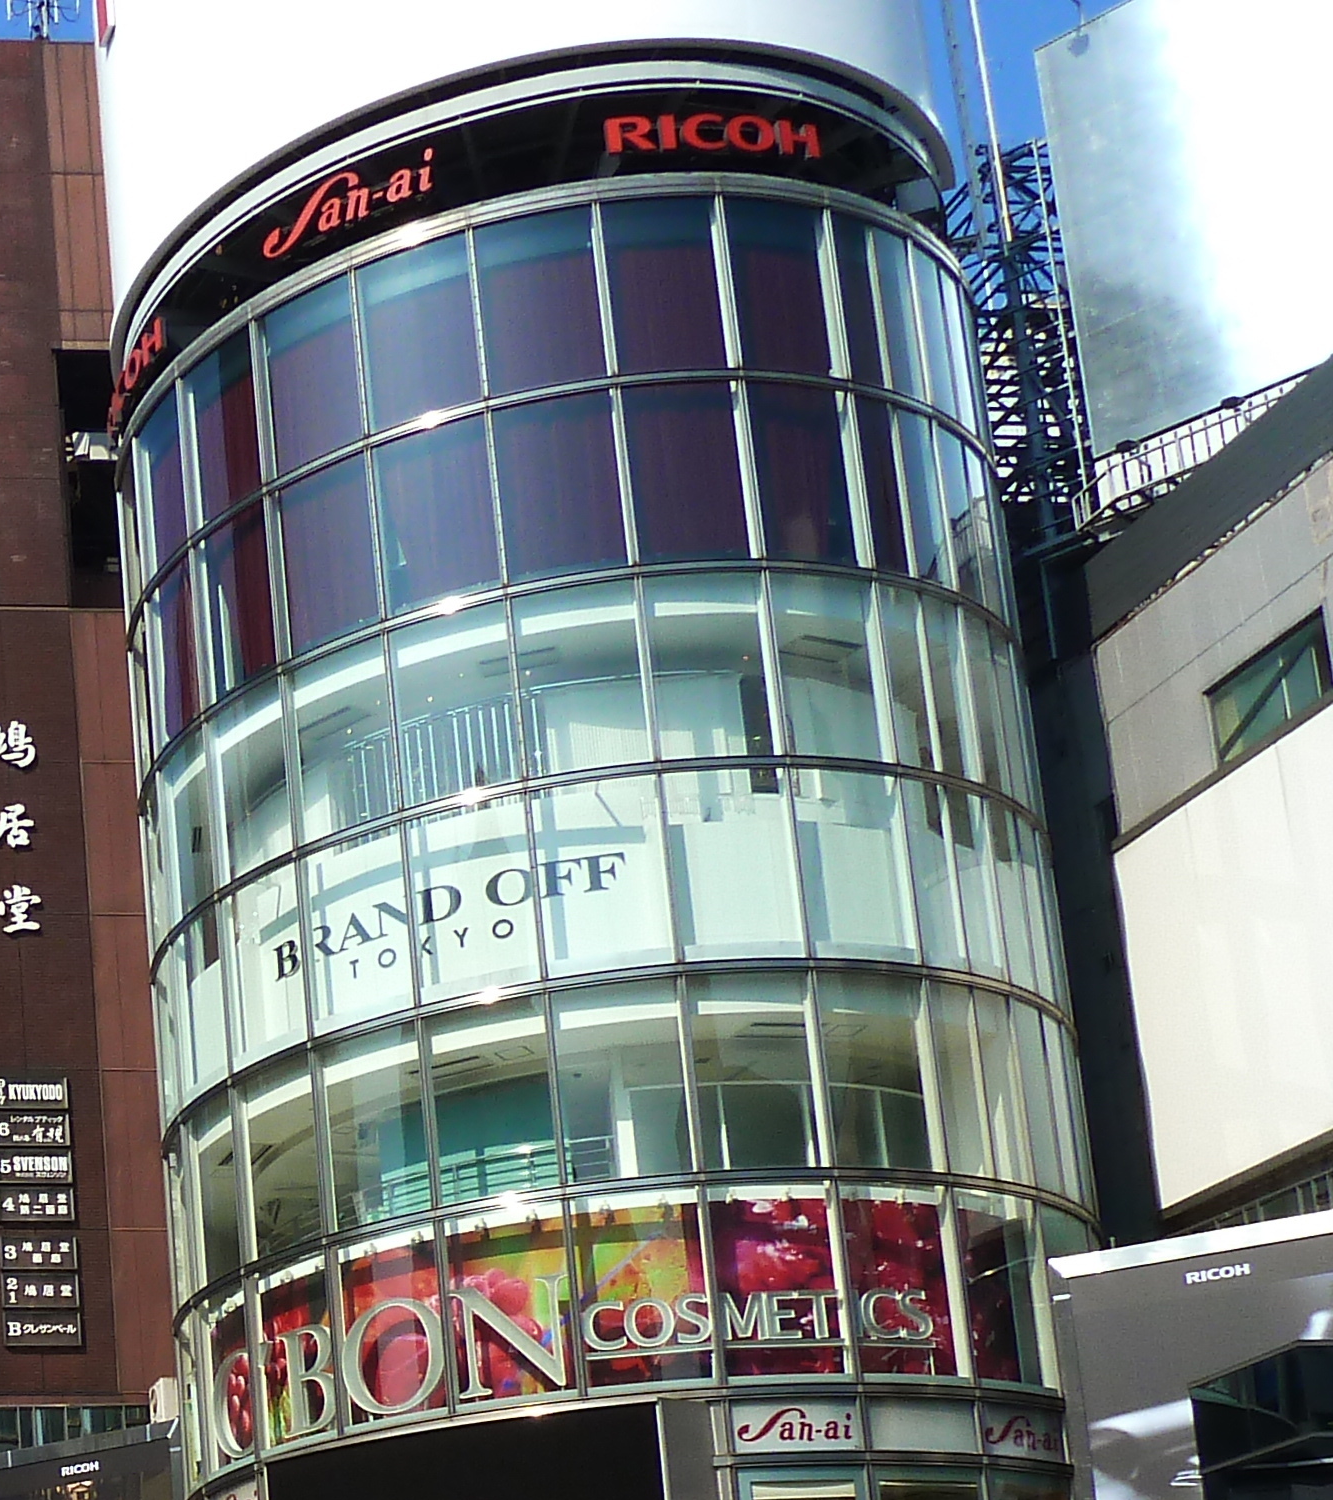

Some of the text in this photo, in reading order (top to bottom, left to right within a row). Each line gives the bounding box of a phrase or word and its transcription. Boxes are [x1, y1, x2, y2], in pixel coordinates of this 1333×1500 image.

[603, 112, 822, 162] RICOH
[273, 850, 626, 985] BRAND OFF
[348, 916, 519, 981] TOKYO
[8, 1083, 63, 1101] KYUKYODO
[0, 1156, 68, 1174] 5 SVENSON
[2, 1197, 15, 1212] 4
[4, 1245, 18, 1260] 3
[1184, 1261, 1251, 1285] RICOH
[6, 1277, 18, 1290] 2
[582, 1286, 935, 1351] COSMETICS
[7, 1321, 23, 1337] B
[736, 1408, 854, 1446] San-ai
[61, 1460, 100, 1477] RICOH
